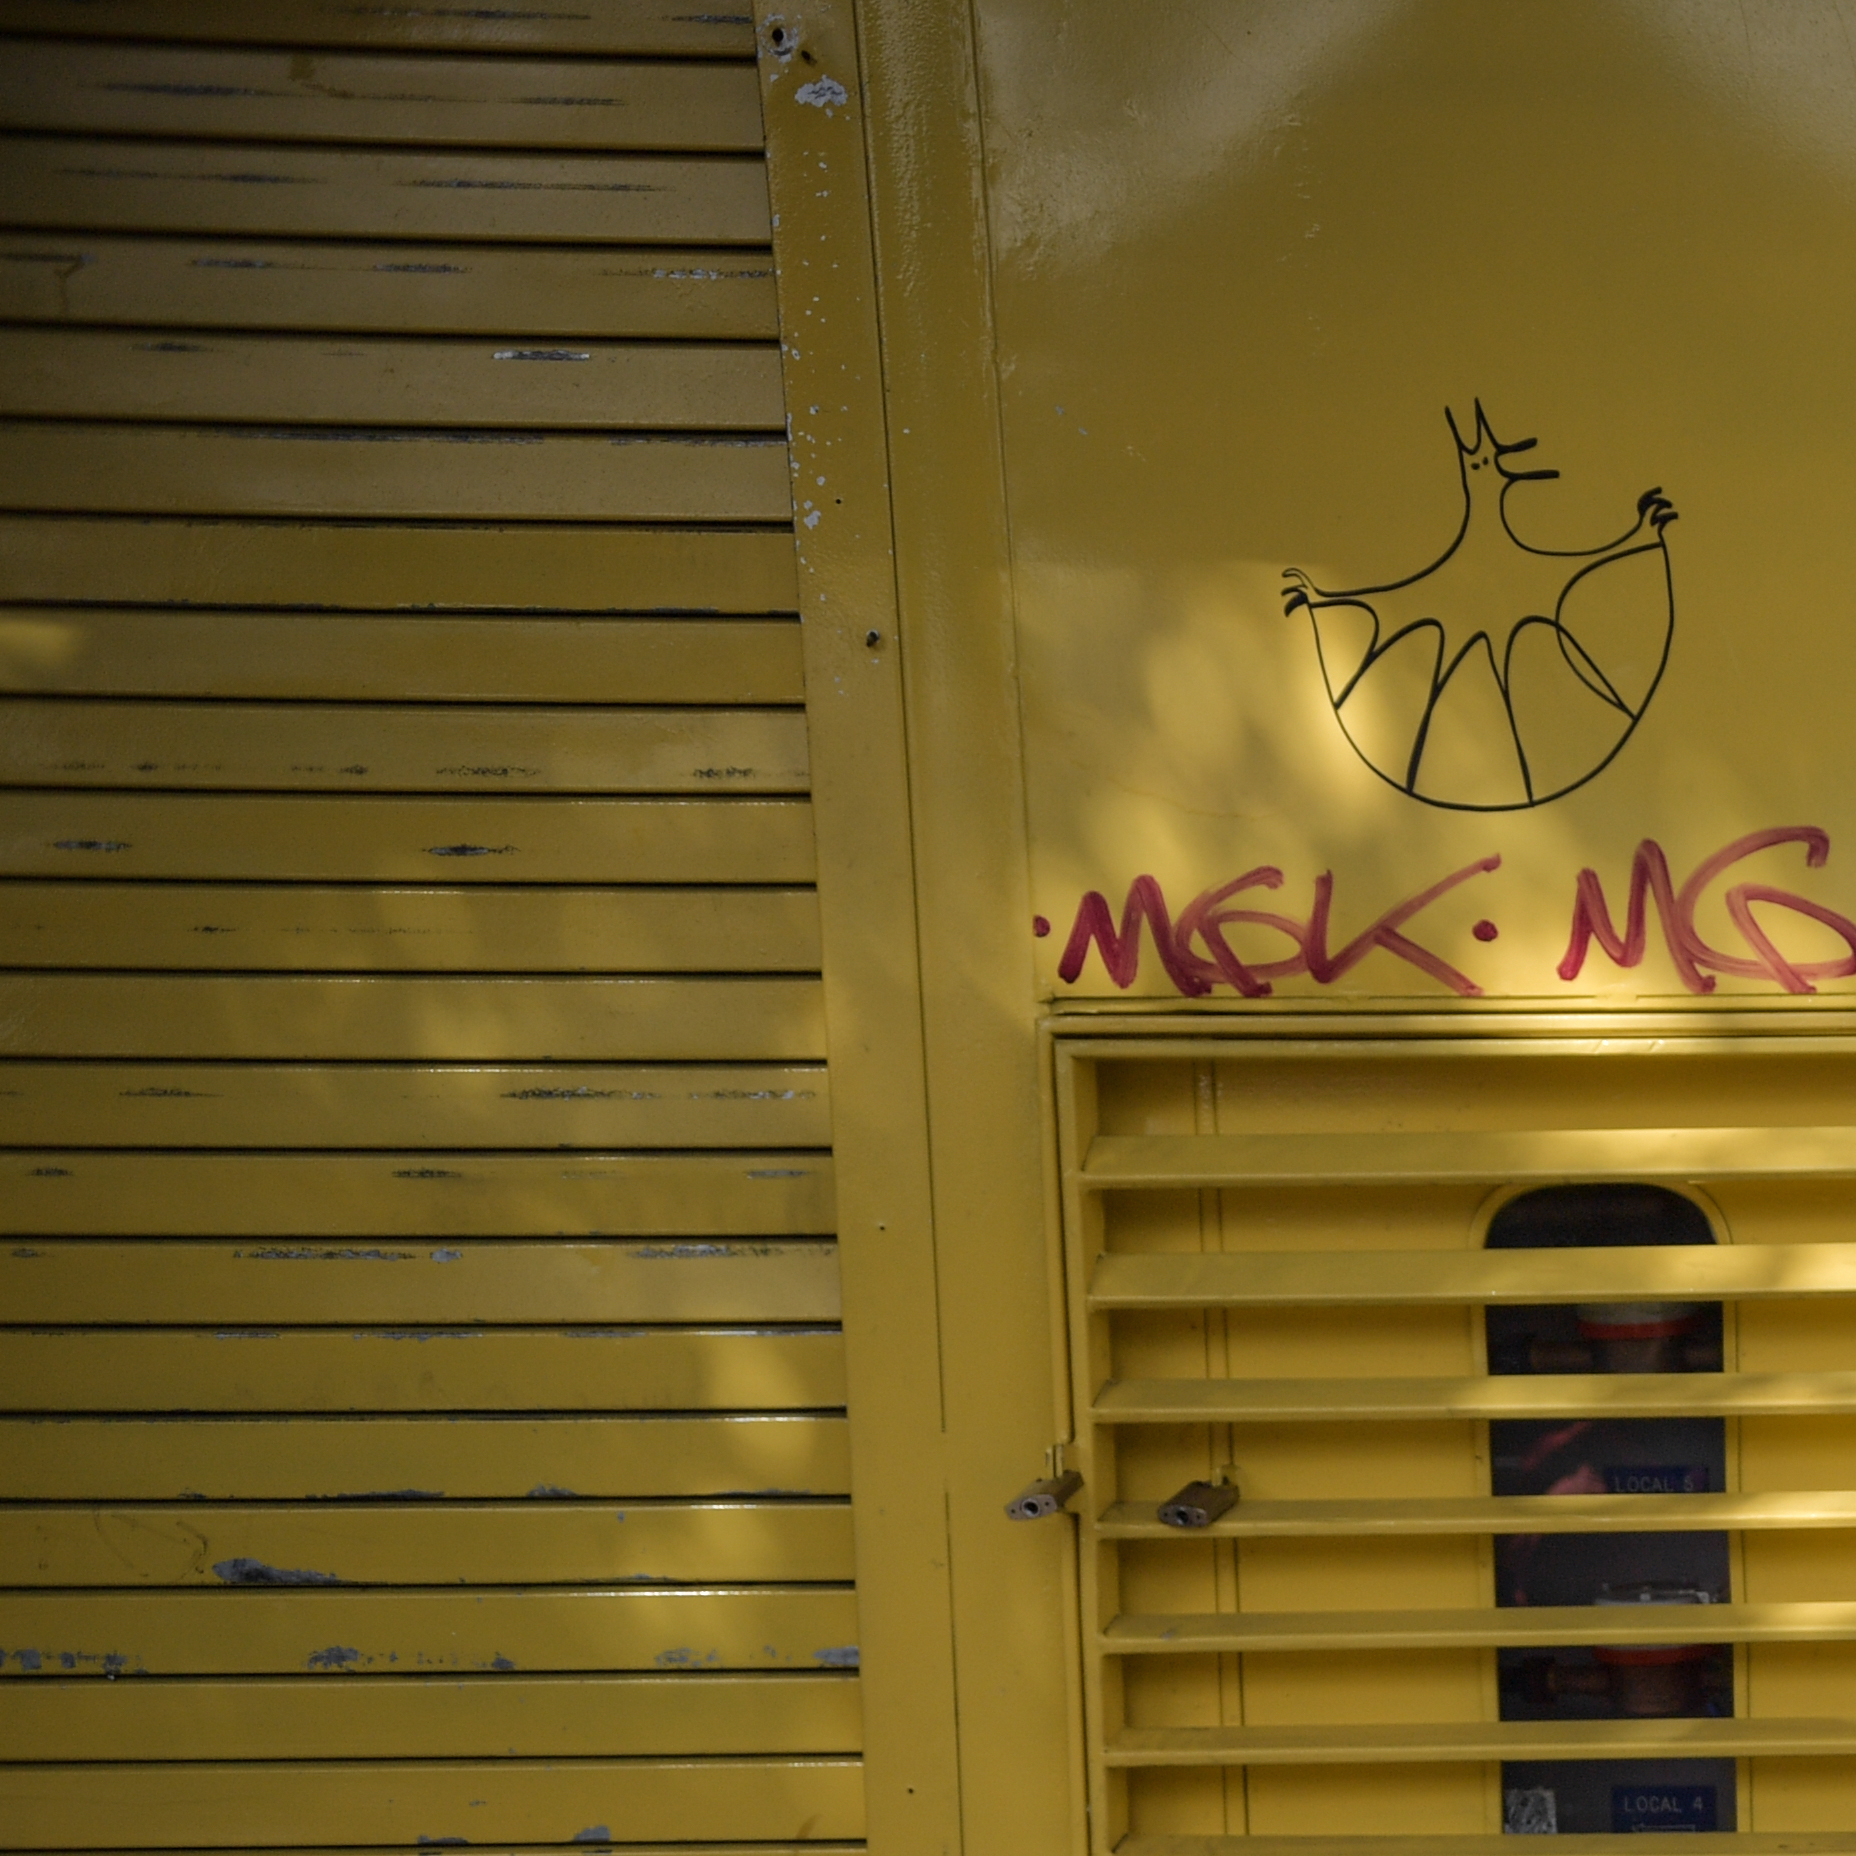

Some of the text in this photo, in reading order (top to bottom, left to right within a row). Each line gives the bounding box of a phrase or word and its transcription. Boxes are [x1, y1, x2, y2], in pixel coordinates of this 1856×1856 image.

[1613, 1475, 1675, 1493] LOCAL
[1623, 1795, 1704, 1813] LOCAL 4
